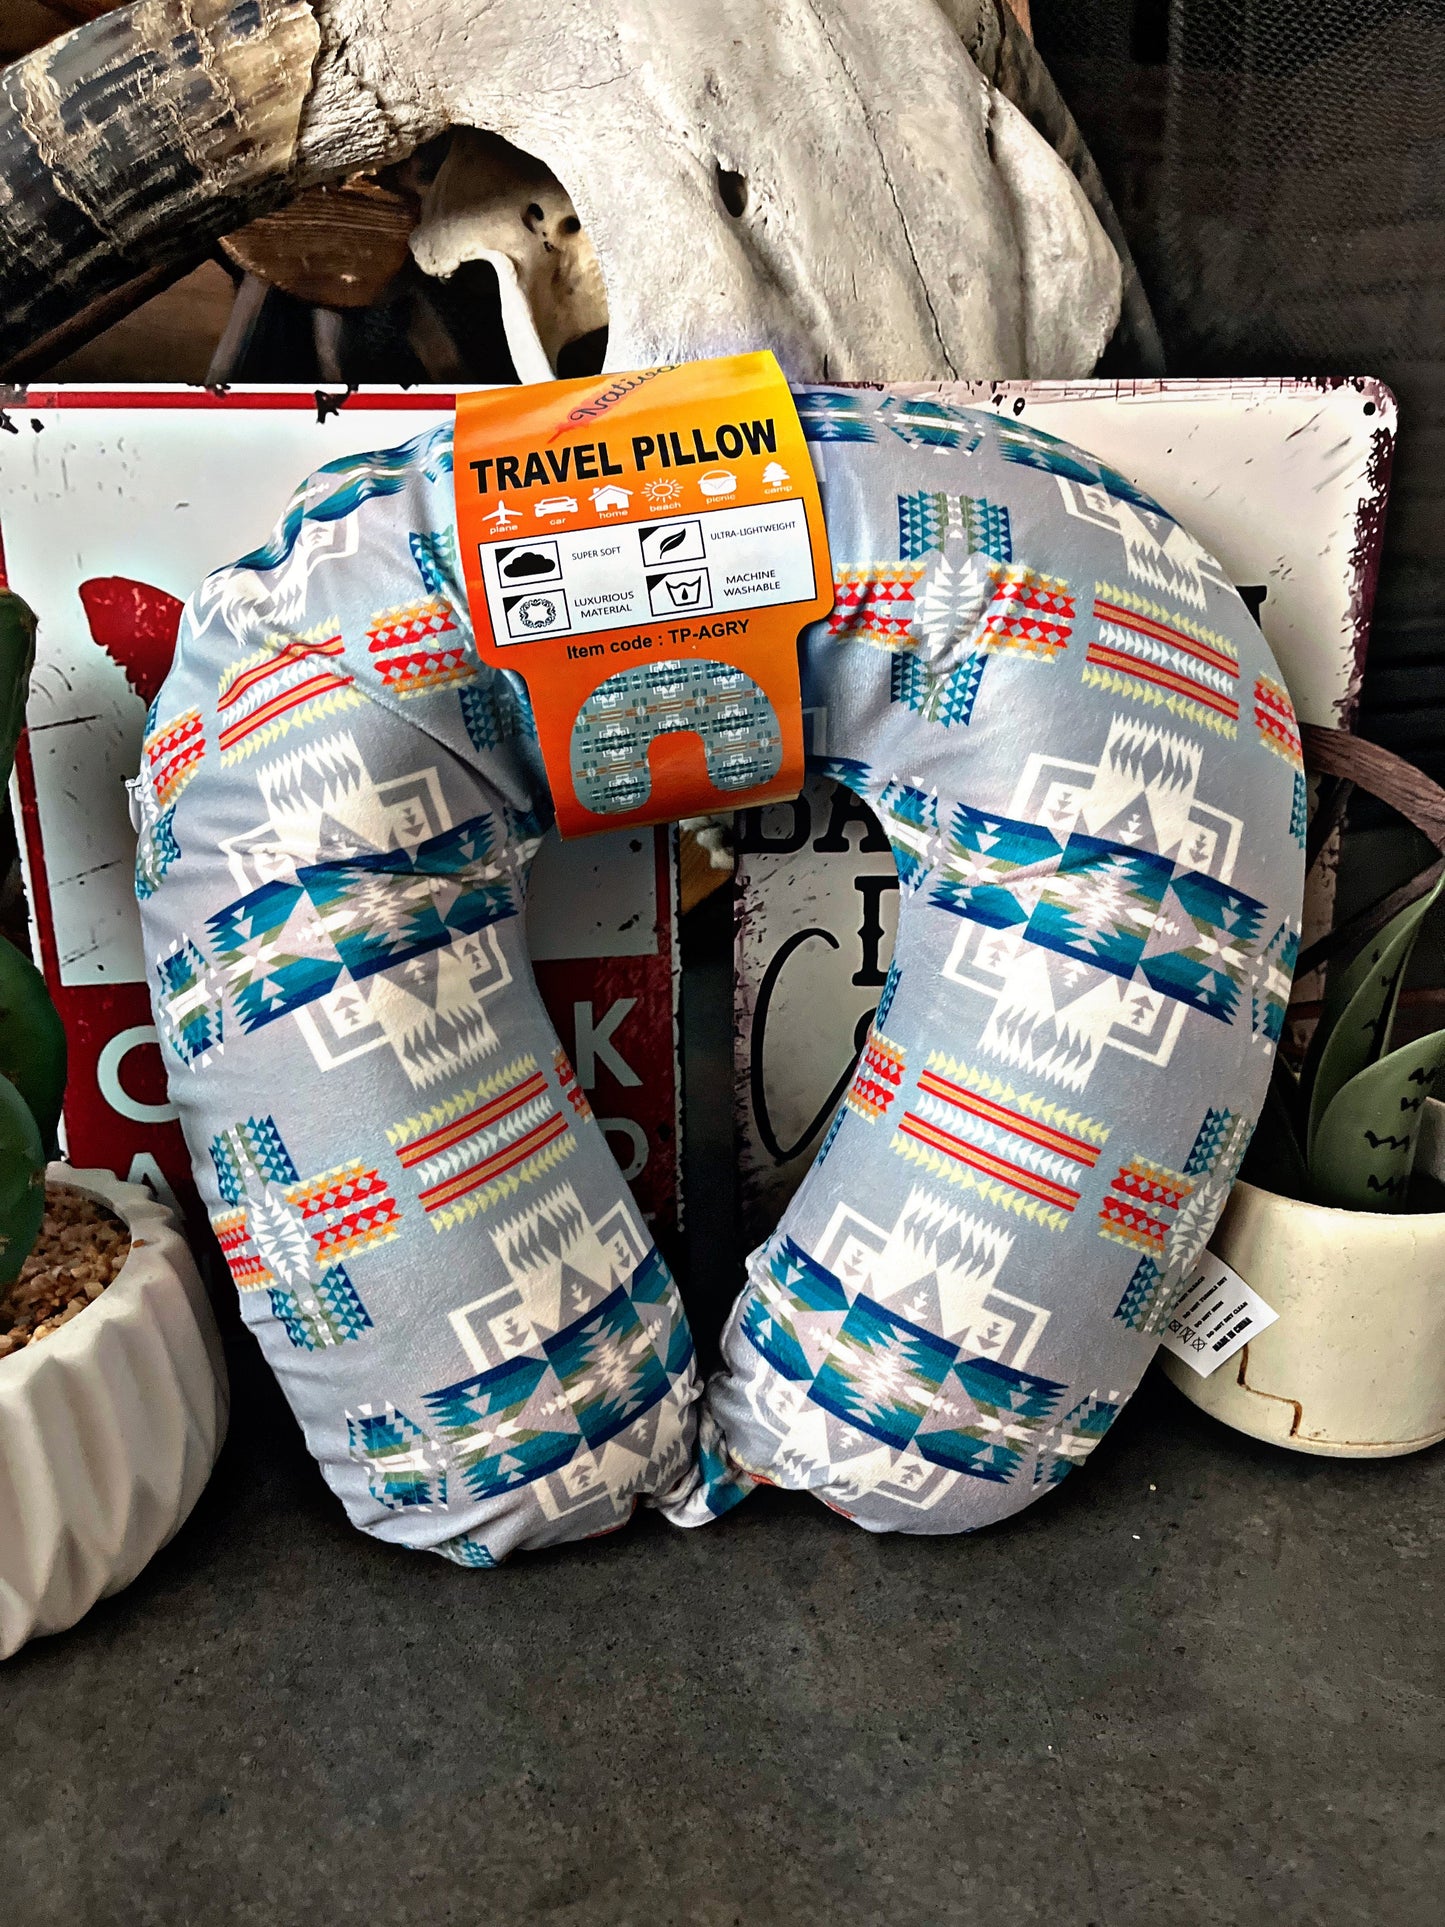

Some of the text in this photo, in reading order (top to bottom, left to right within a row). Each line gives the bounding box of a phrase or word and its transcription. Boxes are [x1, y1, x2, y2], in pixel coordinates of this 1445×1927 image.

[470, 419, 777, 494] TRAVEL PILLOW
[764, 485, 793, 495] camp
[706, 494, 736, 505] picnic
[599, 510, 628, 519] home
[649, 502, 682, 513] beach
[549, 517, 566, 526] car
[489, 524, 518, 535] plane
[710, 521, 796, 540] ULTRA-LIGHTWEIGHT
[571, 546, 622, 561] SUPER SOFT
[726, 569, 776, 584] MACHINE
[723, 581, 781, 597] WASHABLE
[574, 591, 635, 607] LUXURIOUS
[580, 604, 632, 619] MATERIAL
[567, 644, 605, 660] Item
[610, 635, 653, 653] code
[668, 619, 750, 643] TP-AGRY
